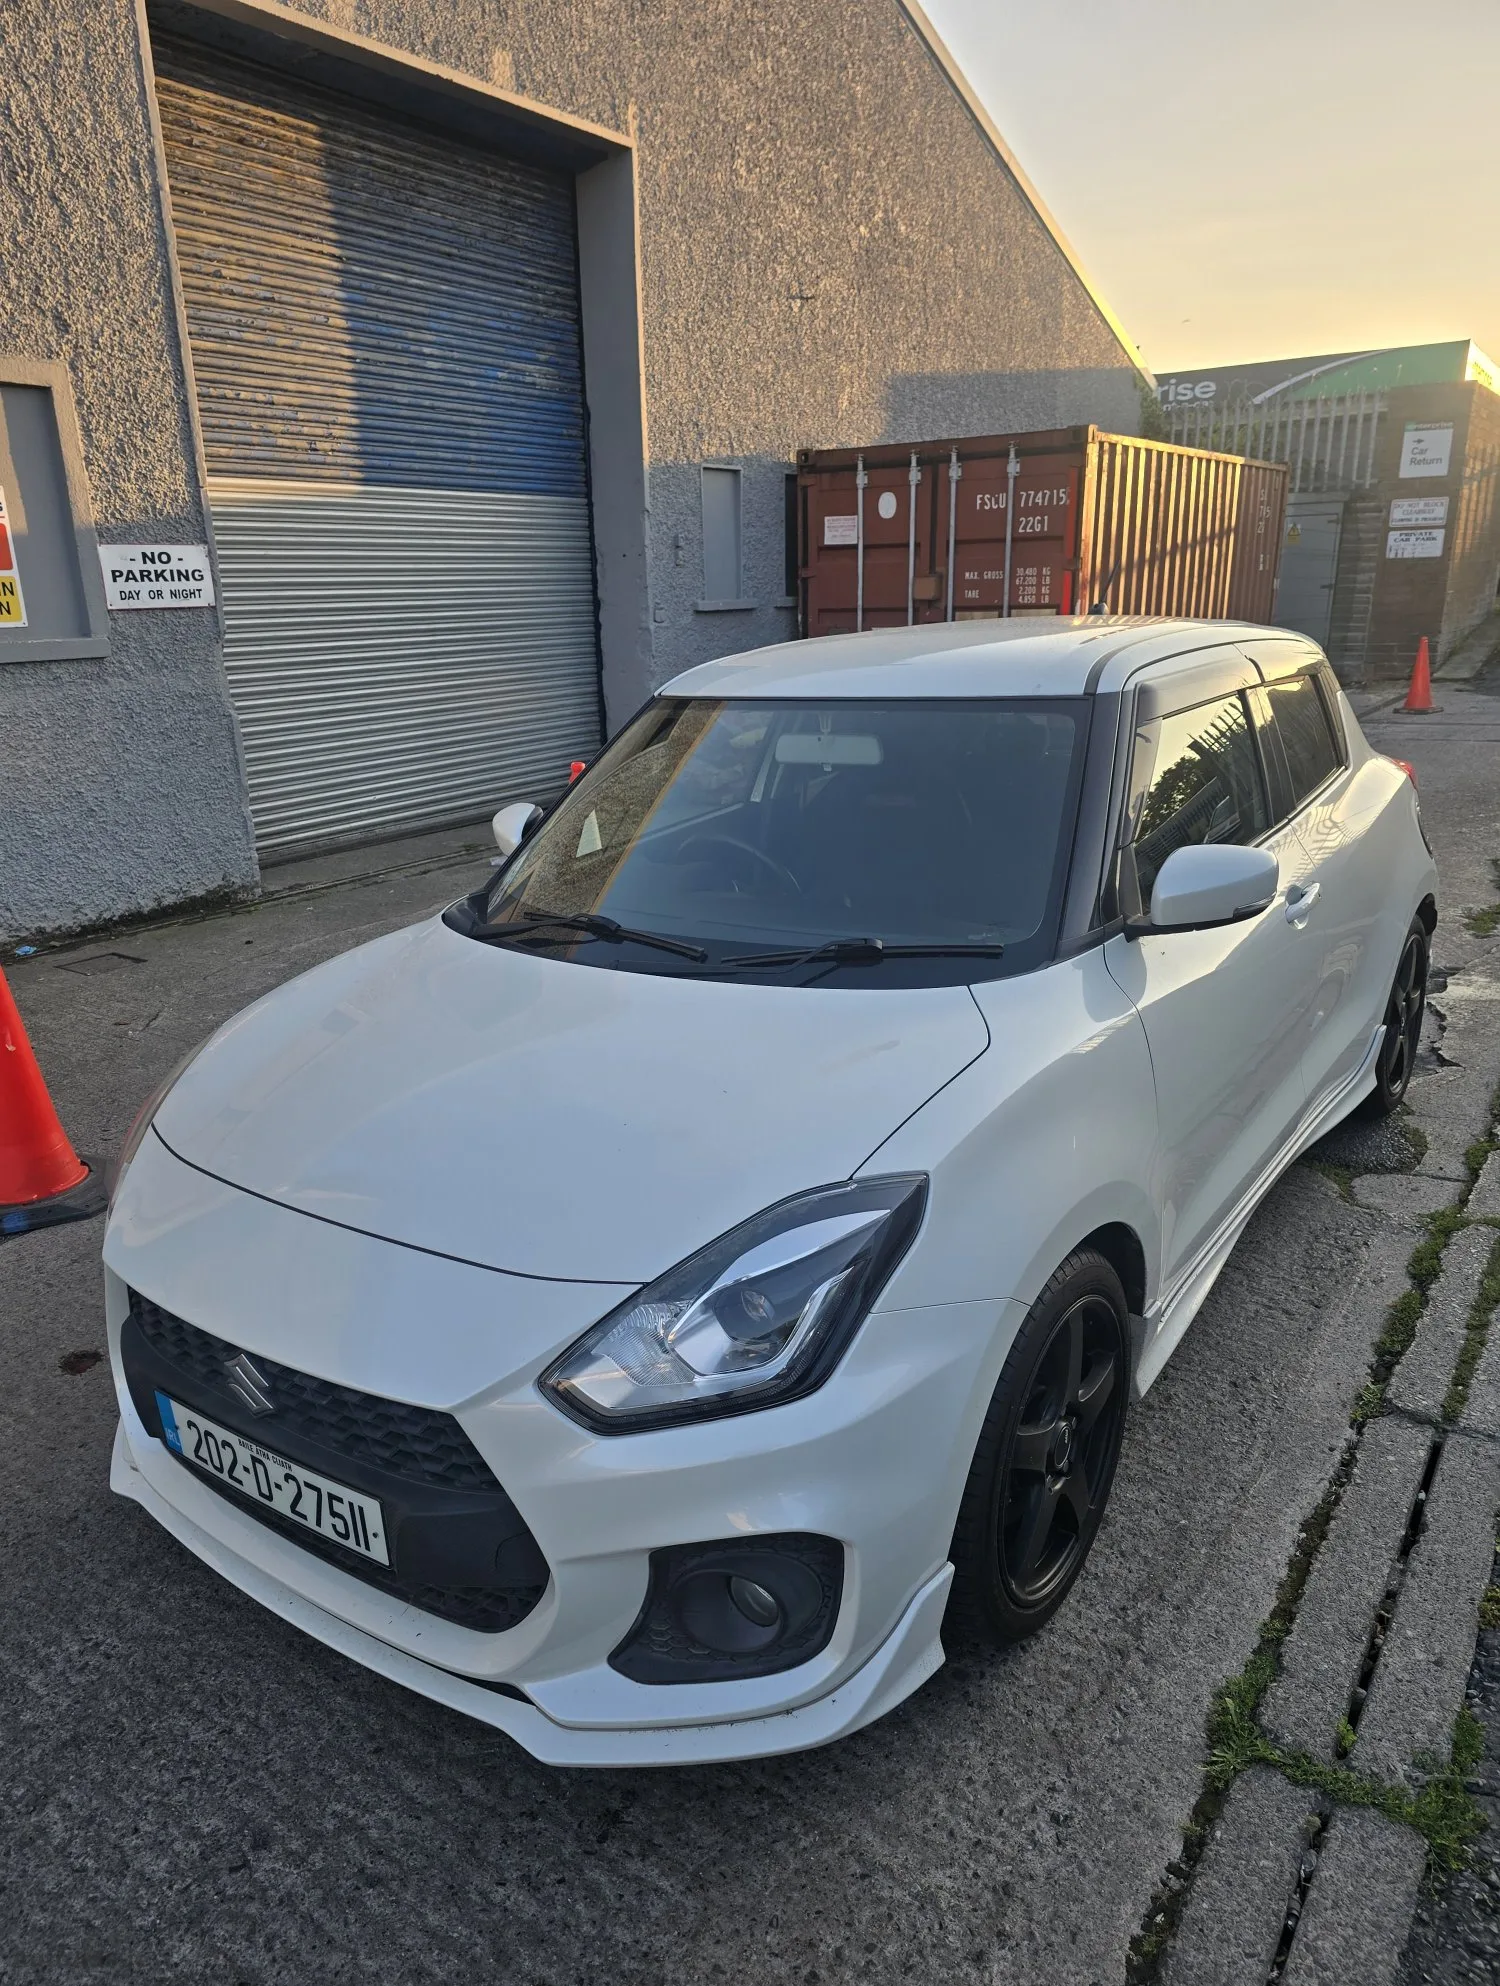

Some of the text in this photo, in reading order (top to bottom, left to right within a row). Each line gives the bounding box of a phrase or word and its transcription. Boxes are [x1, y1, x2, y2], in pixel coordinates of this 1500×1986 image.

[1157, 378, 1216, 401] rise
[1411, 447, 1428, 456] Car
[1409, 457, 1442, 466] Return
[976, 492, 1007, 510] FSCU
[1018, 516, 1048, 533] 22G1
[142, 552, 172, 565] NO
[111, 568, 205, 583] PARKING
[964, 571, 980, 580] MAX.
[983, 570, 1004, 580] GROSS
[1042, 566, 1051, 576] KG
[119, 589, 203, 601] DAY OR NIGHT
[964, 589, 980, 599] TARE
[1041, 585, 1050, 595] KG
[165, 1428, 181, 1446] IRL
[186, 1419, 371, 1552] 202-D-27511
